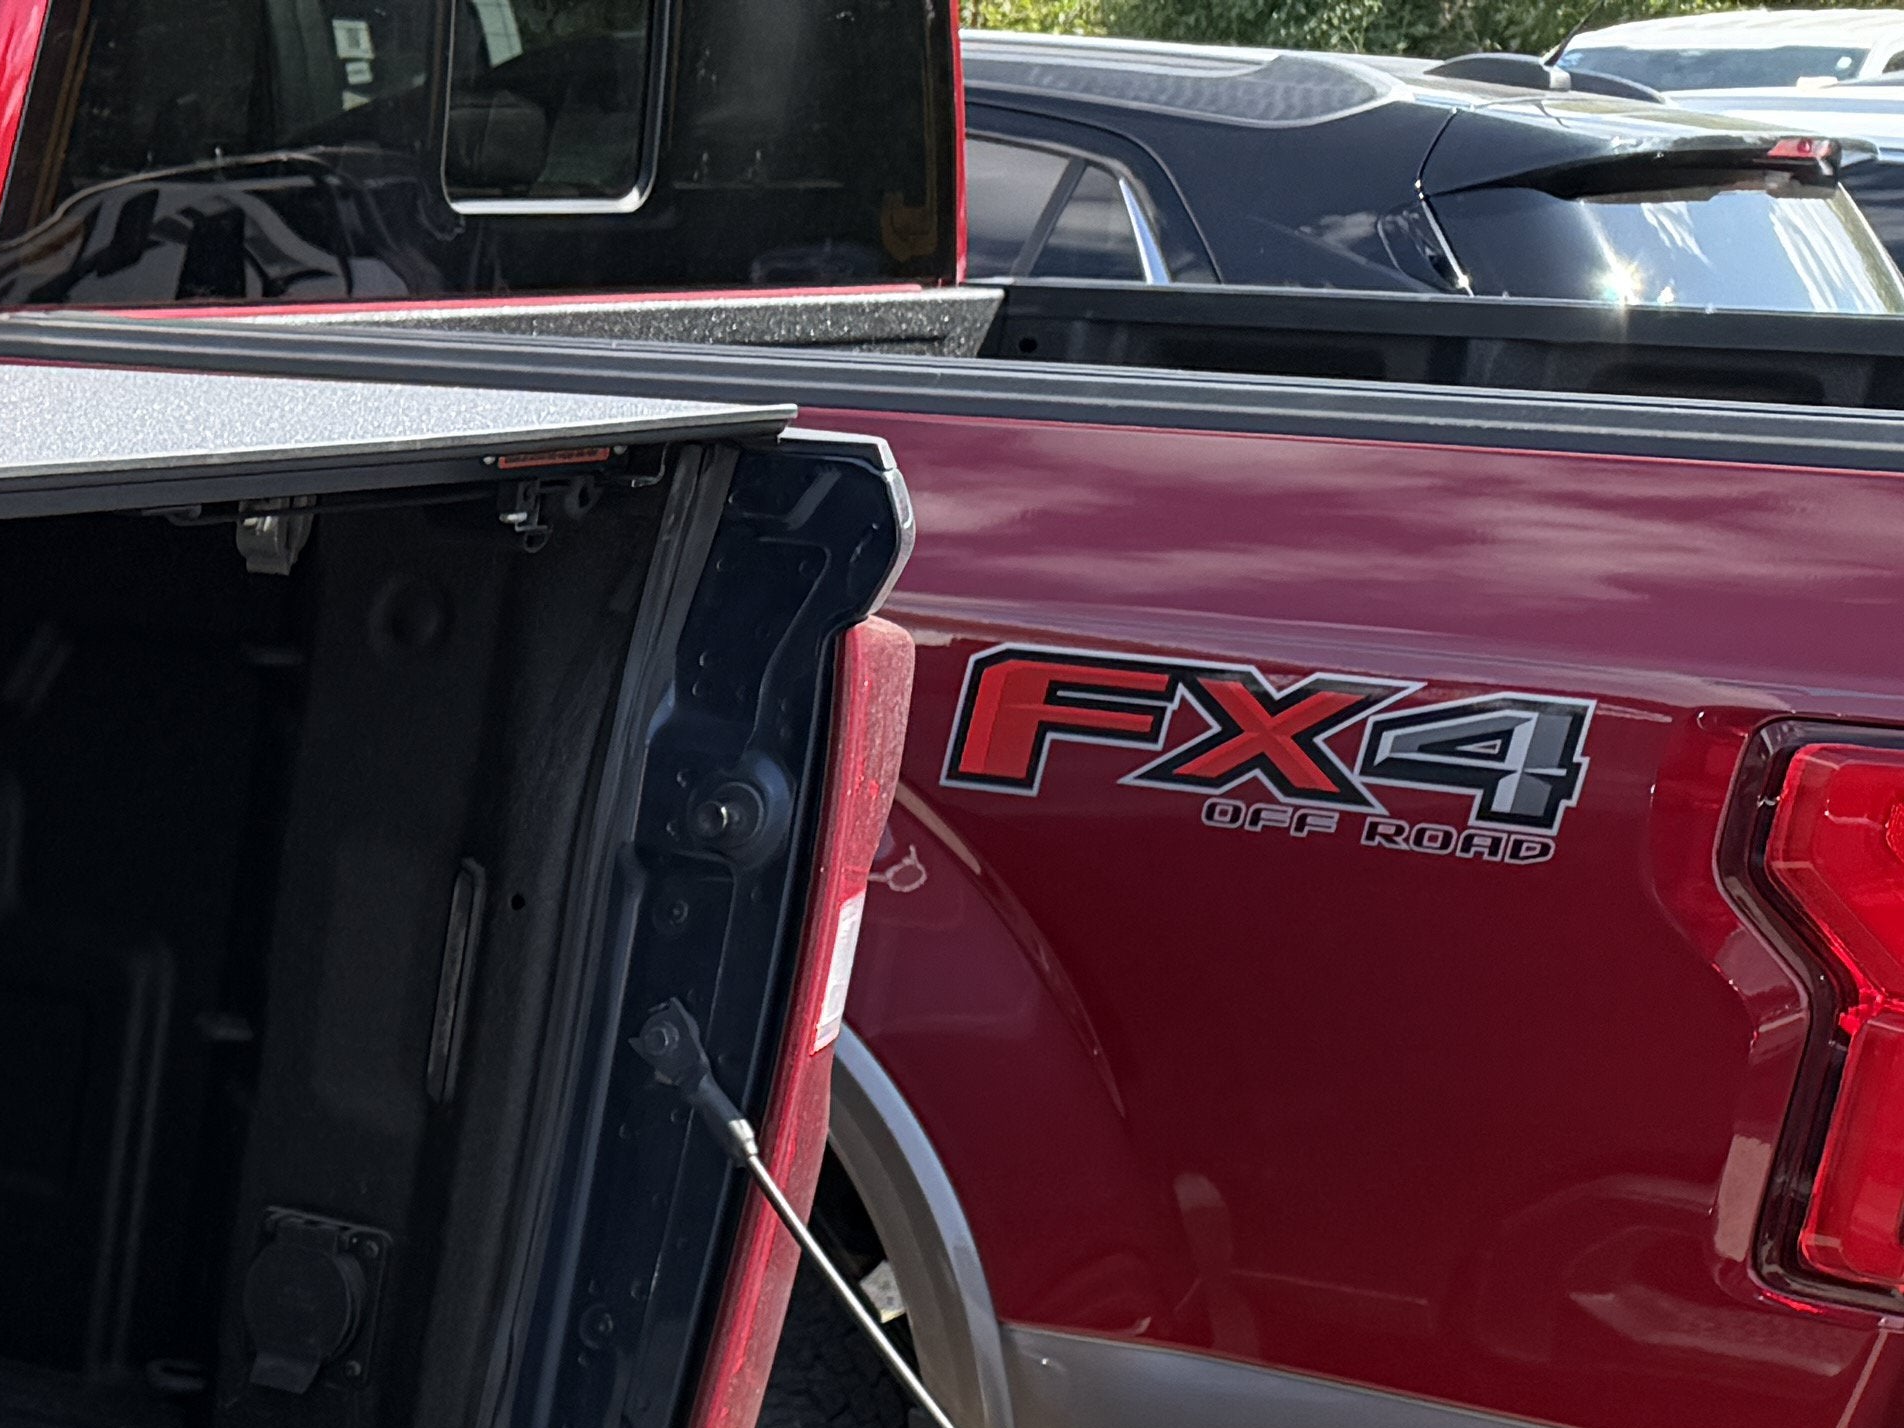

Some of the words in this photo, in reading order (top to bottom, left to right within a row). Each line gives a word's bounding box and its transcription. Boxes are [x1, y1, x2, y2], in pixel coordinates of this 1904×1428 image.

[940, 643, 1596, 834] FX4
[1200, 799, 1339, 837] OFF
[1361, 815, 1555, 865] ROAD
